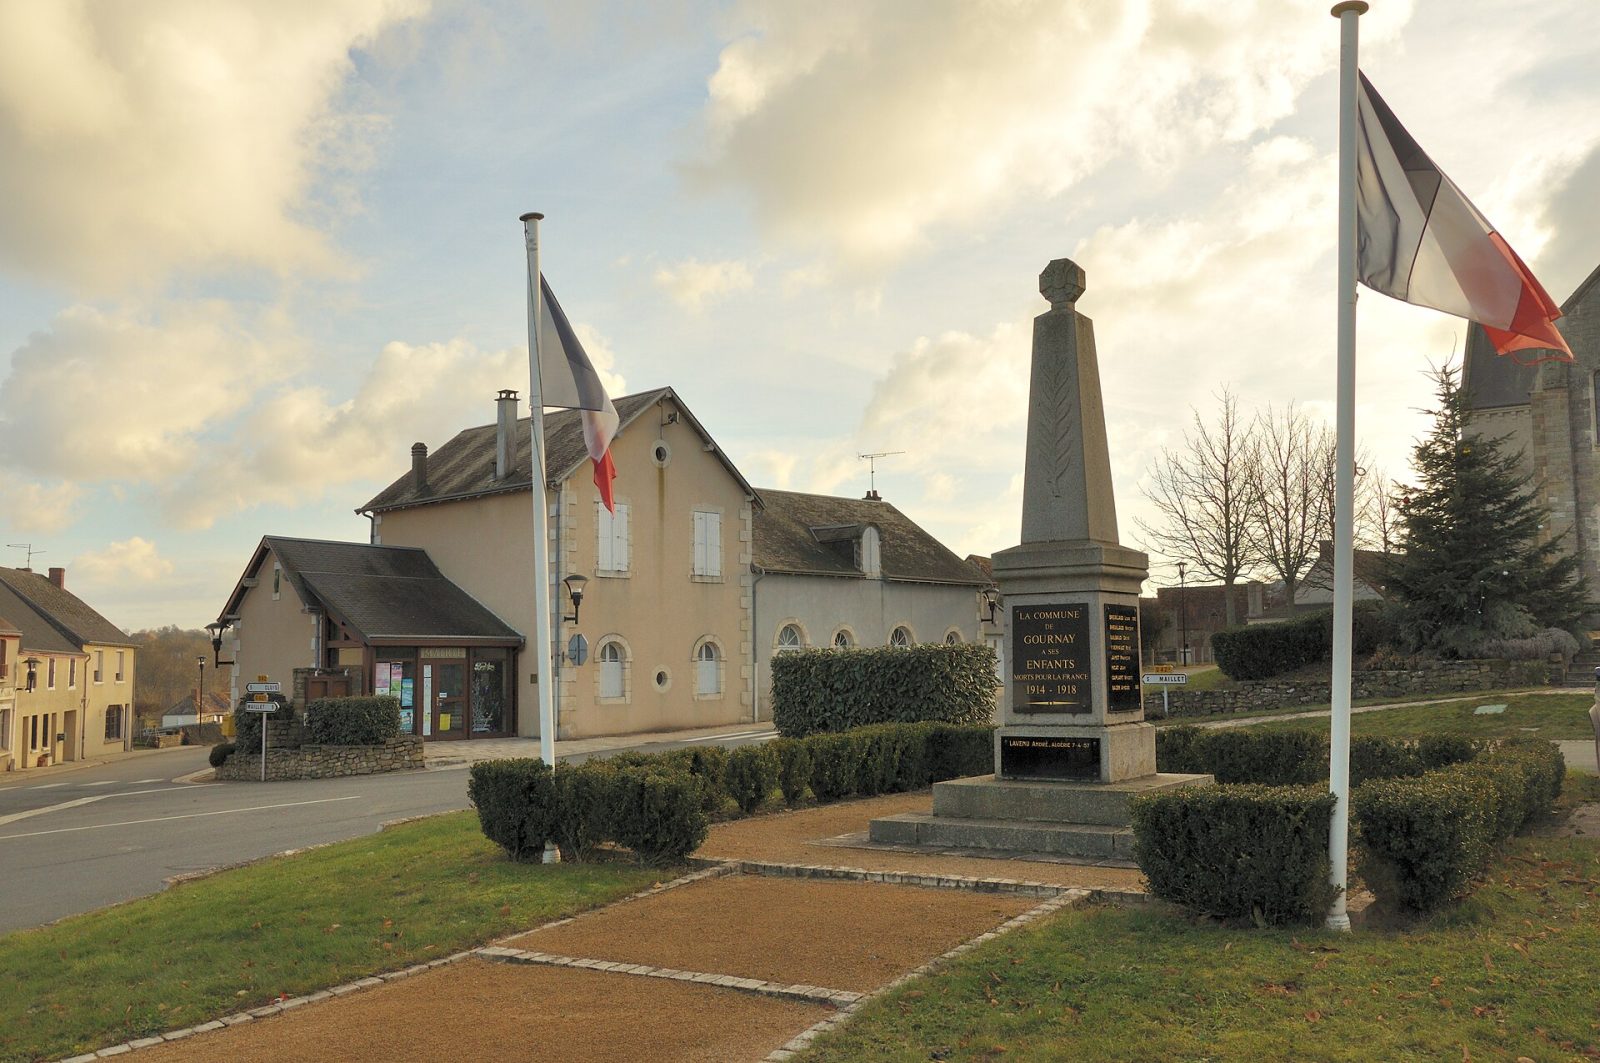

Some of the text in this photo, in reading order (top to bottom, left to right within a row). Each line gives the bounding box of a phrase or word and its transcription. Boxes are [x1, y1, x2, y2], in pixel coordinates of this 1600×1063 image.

[1019, 610, 1080, 620] LA COMMUNE
[1023, 633, 1076, 645] GOURNAY
[1026, 659, 1075, 670] ENFANTS
[1013, 673, 1034, 681] MORTS
[1034, 673, 1052, 681] POUR
[1026, 684, 1046, 695] 1914
[1056, 684, 1077, 695] 1918
